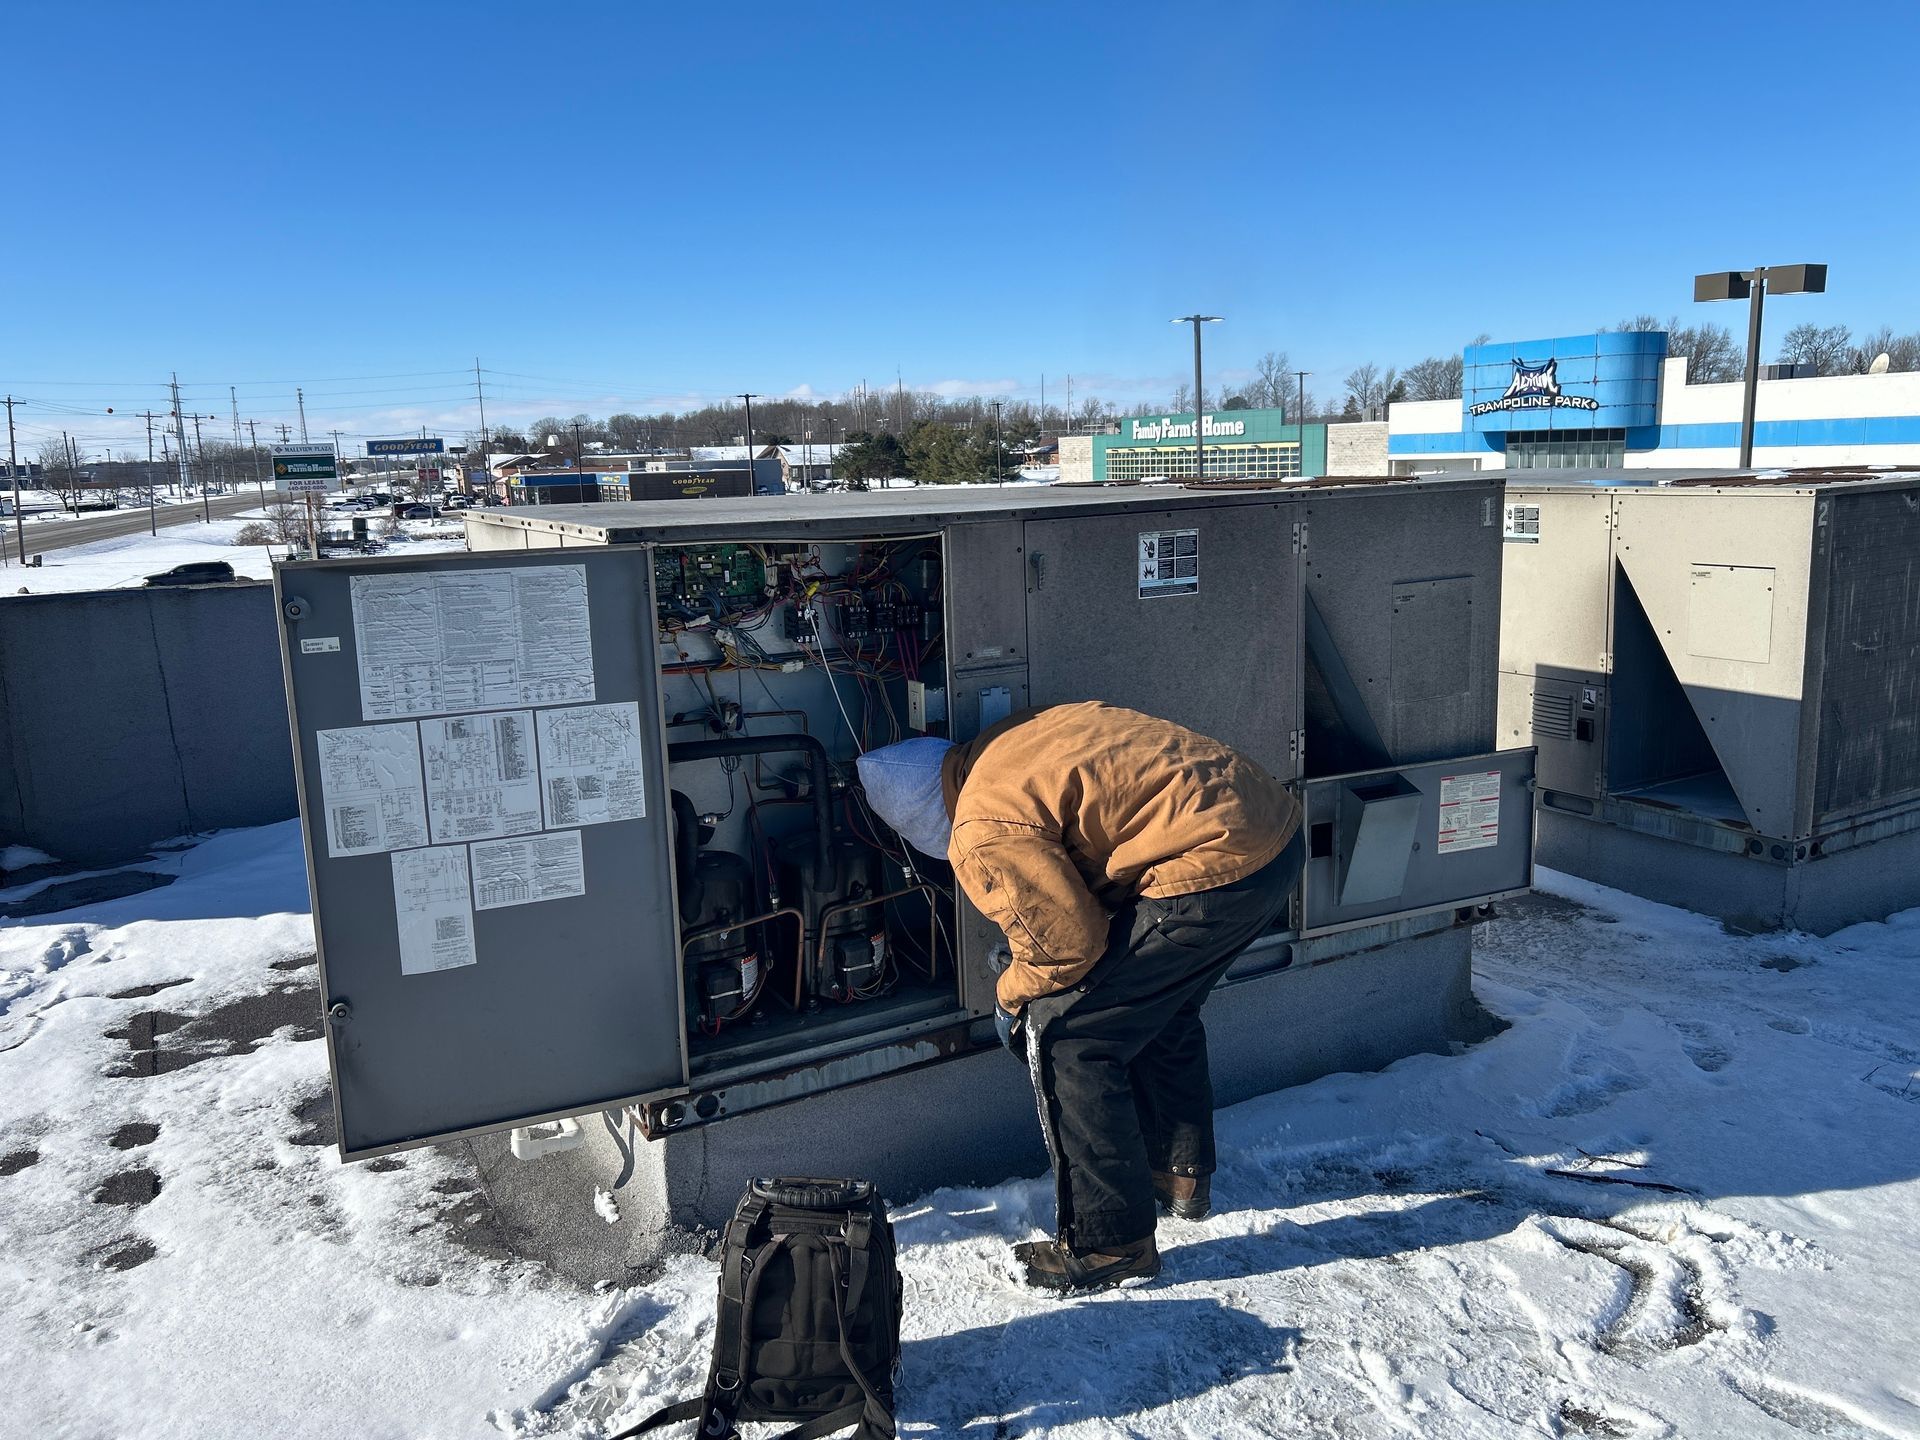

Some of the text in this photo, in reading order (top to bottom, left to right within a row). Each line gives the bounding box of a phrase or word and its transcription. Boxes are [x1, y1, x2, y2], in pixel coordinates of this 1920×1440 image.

[1470, 396, 1551, 415] TRAMPOLINE
[1132, 419, 1161, 443] Family
[1161, 418, 1191, 438] Farm
[1201, 415, 1245, 437] Home
[374, 442, 436, 451] GOODYEAR
[287, 464, 307, 472] Farm
[312, 463, 335, 472] Home
[1483, 497, 1492, 527] 1
[1817, 502, 1828, 527] 2
